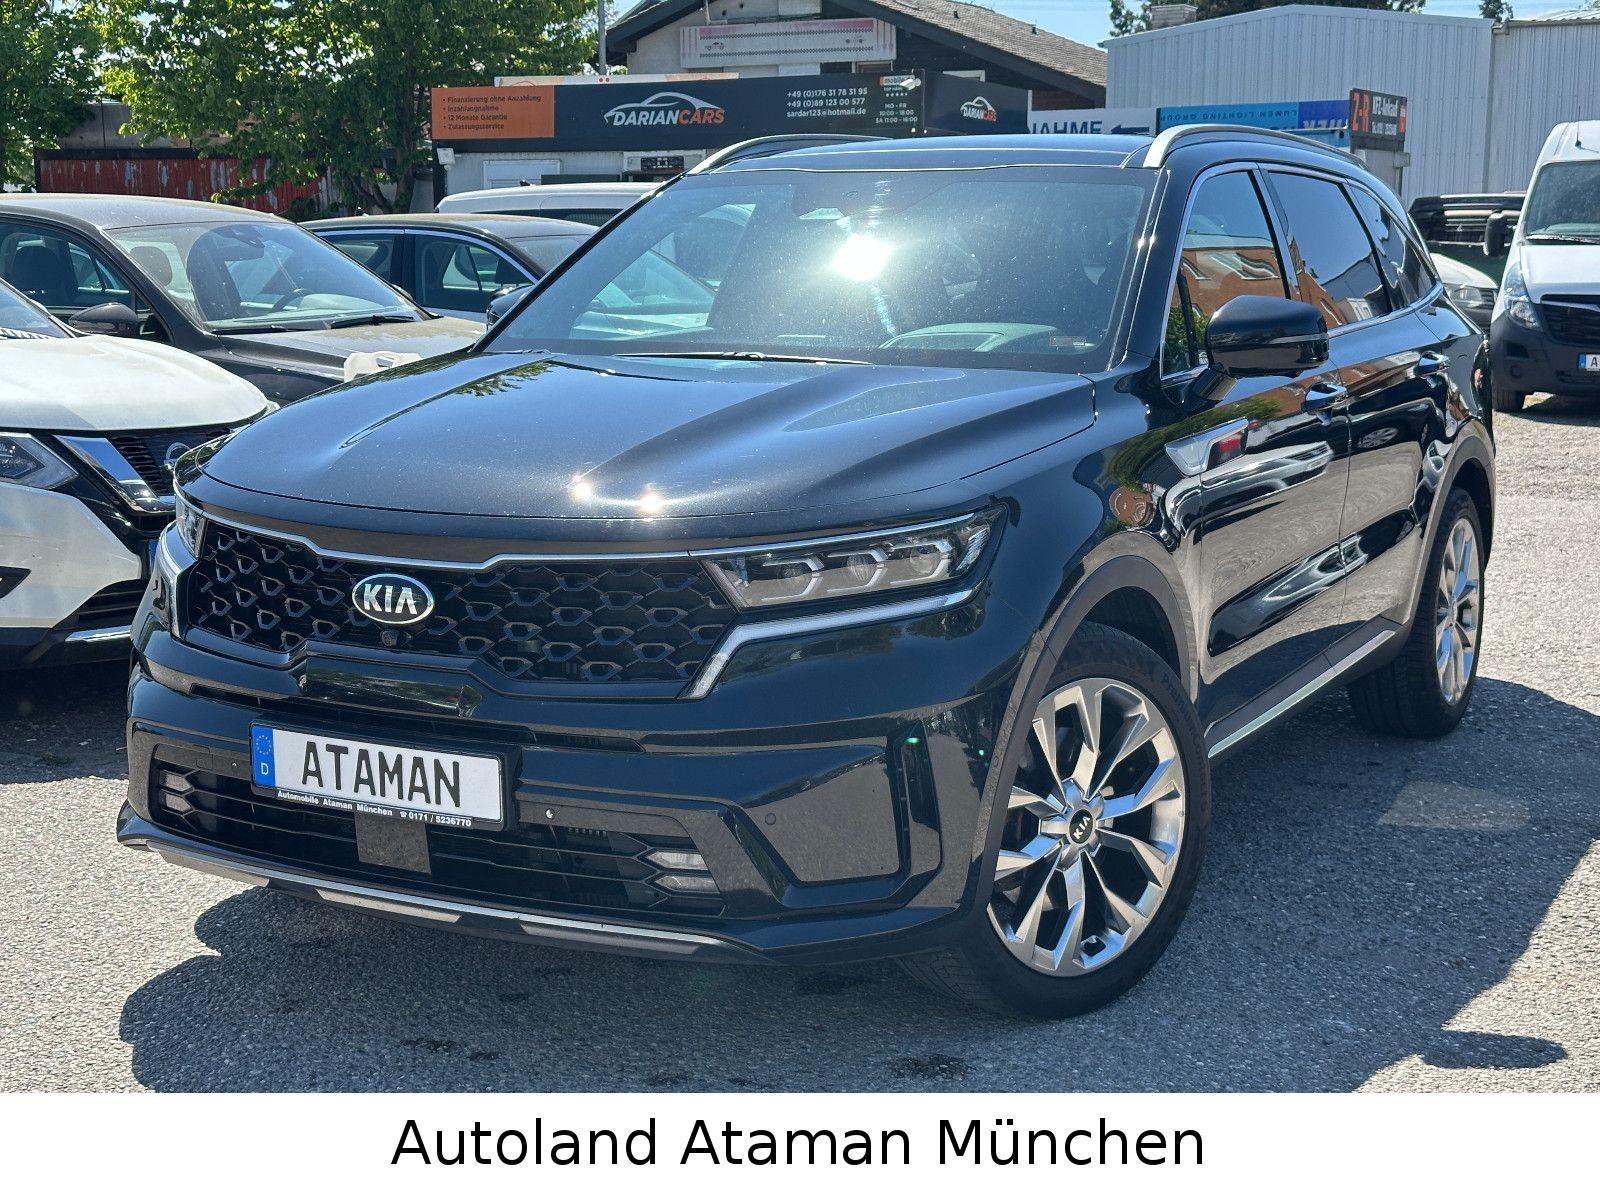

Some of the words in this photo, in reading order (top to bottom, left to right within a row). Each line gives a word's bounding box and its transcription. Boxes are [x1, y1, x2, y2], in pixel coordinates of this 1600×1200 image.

[786, 90, 802, 98] +49
[828, 89, 836, 97] 31
[838, 88, 847, 96] 78
[848, 88, 857, 96] 31
[857, 87, 868, 95] 95
[448, 96, 488, 104] Finanzierung
[507, 94, 542, 103] Anzahlung
[786, 100, 802, 108] +49
[802, 99, 824, 108] (0)89
[825, 98, 838, 106] 123
[839, 98, 850, 106] 00
[851, 97, 866, 106] 577
[613, 107, 726, 127] DARIANCARS
[786, 107, 867, 118] sardar123@hotmail.de
[1160, 113, 1197, 122] GROUP
[1202, 111, 1254, 120] LIGHTING
[1259, 109, 1297, 118] LUMEN
[447, 123, 505, 131] Zulassungsservice
[363, 583, 418, 615] KIA
[260, 762, 269, 776] D
[301, 741, 460, 808] ATAMAN
[277, 790, 320, 805] Automobile
[322, 798, 354, 811] Ataman
[356, 803, 393, 817] München
[408, 812, 428, 822] 0171
[435, 815, 472, 827] 5236770
[1073, 816, 1091, 840] KIA
